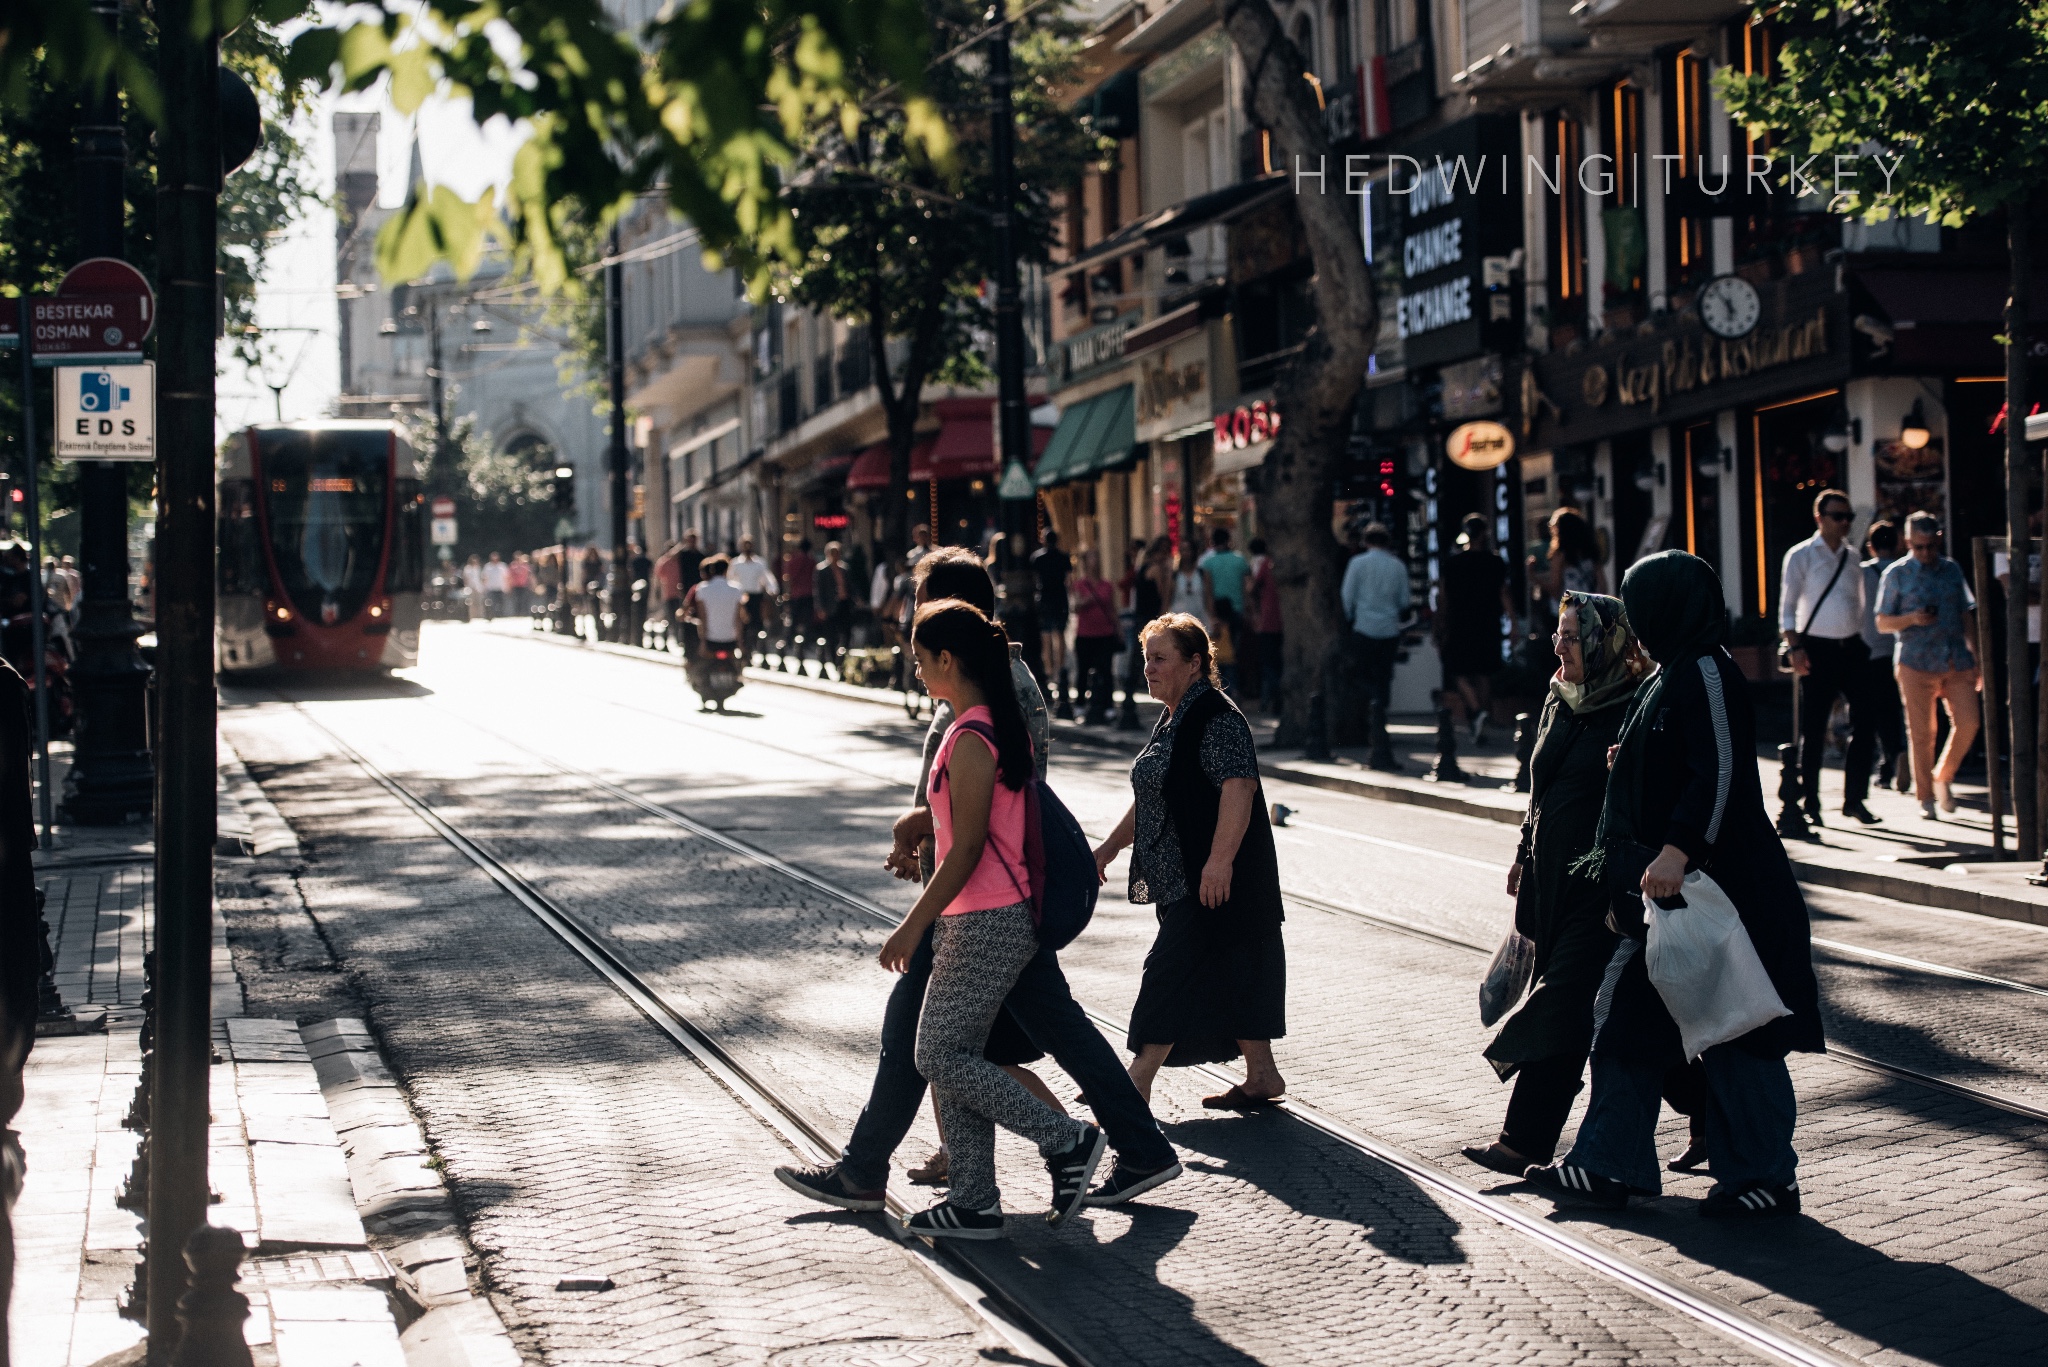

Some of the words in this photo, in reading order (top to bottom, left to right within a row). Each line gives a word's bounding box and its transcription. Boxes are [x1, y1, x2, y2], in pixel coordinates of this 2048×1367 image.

[1404, 217, 1462, 278] CHANGE
[35, 304, 114, 319] BESTEKAR
[1397, 275, 1471, 340] EXCHANGE
[36, 325, 90, 339] OSMAN
